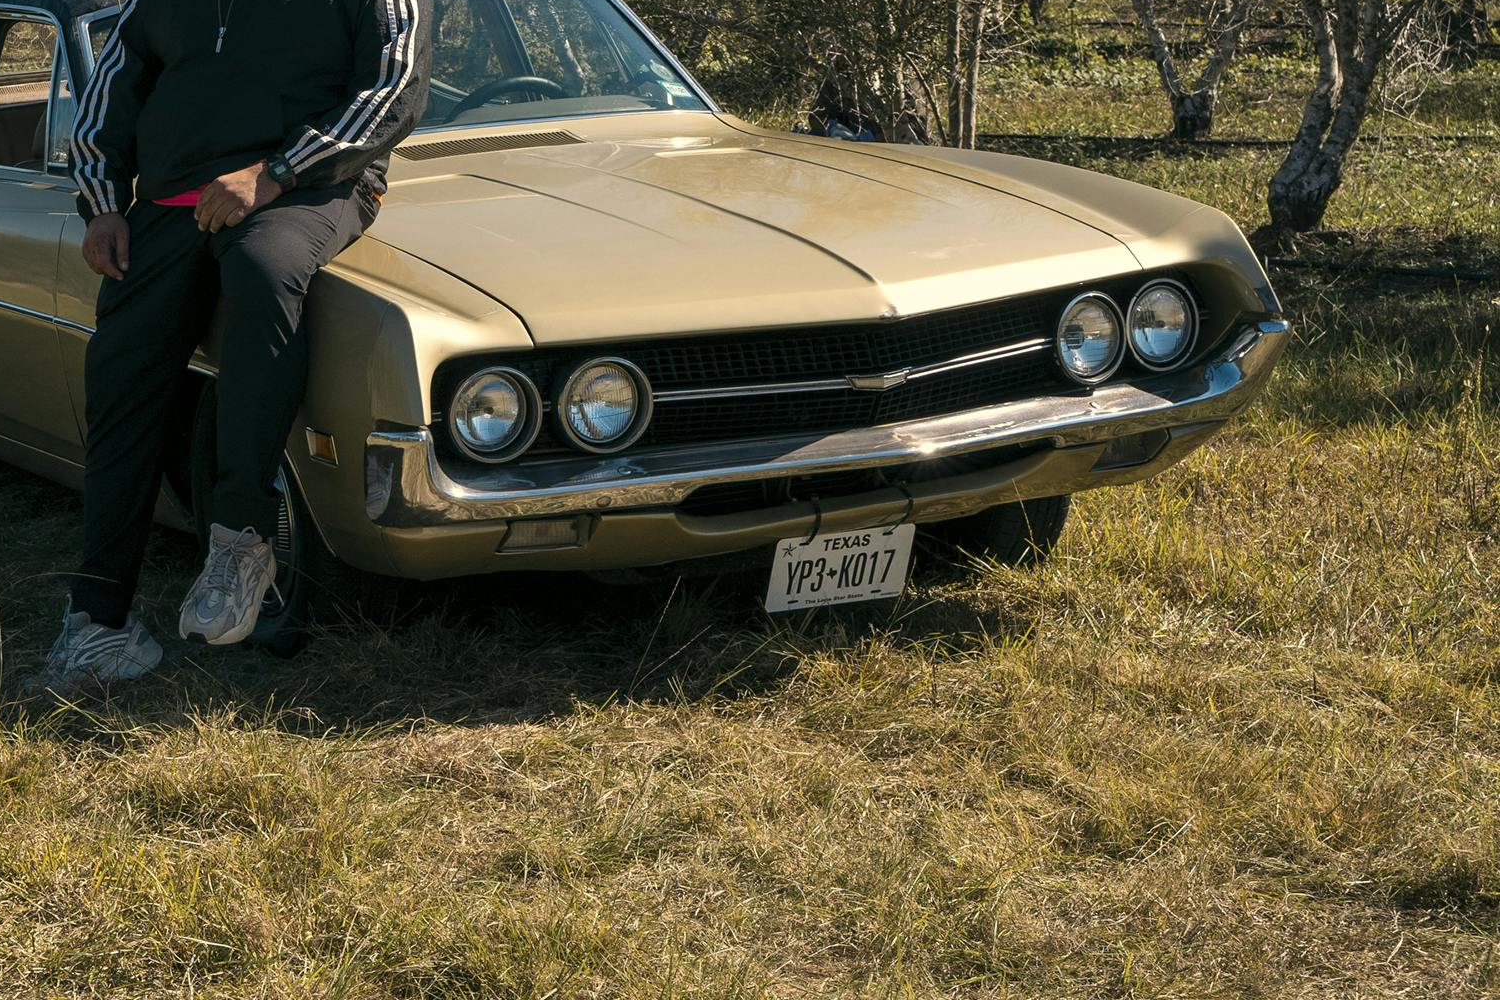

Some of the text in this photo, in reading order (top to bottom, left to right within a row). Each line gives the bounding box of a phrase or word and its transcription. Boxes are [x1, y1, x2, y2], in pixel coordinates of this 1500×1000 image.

[823, 534, 871, 551] TEXAS
[786, 549, 896, 595] YP3 K017
